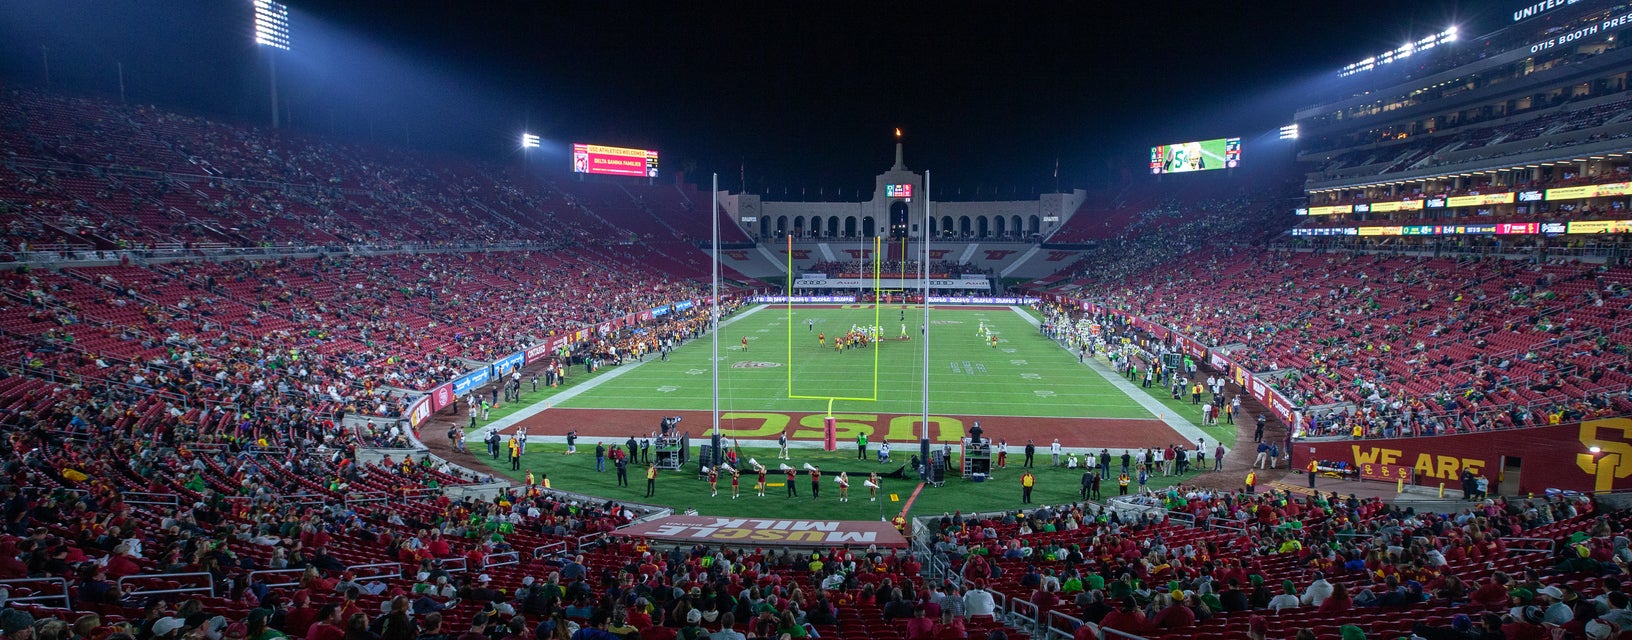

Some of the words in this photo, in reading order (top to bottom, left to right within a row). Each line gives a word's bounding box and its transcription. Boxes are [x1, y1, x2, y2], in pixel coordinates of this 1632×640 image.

[1530, 40, 1555, 53] OTIS
[1559, 25, 1598, 45] BOOTH
[600, 147, 622, 155] ATHLETICS
[622, 149, 645, 157] WELCOMES
[1503, 224, 1511, 233] 17
[702, 412, 966, 442] USC
[1352, 445, 1402, 468] WE
[1414, 453, 1486, 481] ARE
[706, 518, 840, 531] MILK
[644, 525, 877, 542] MUSCLE
